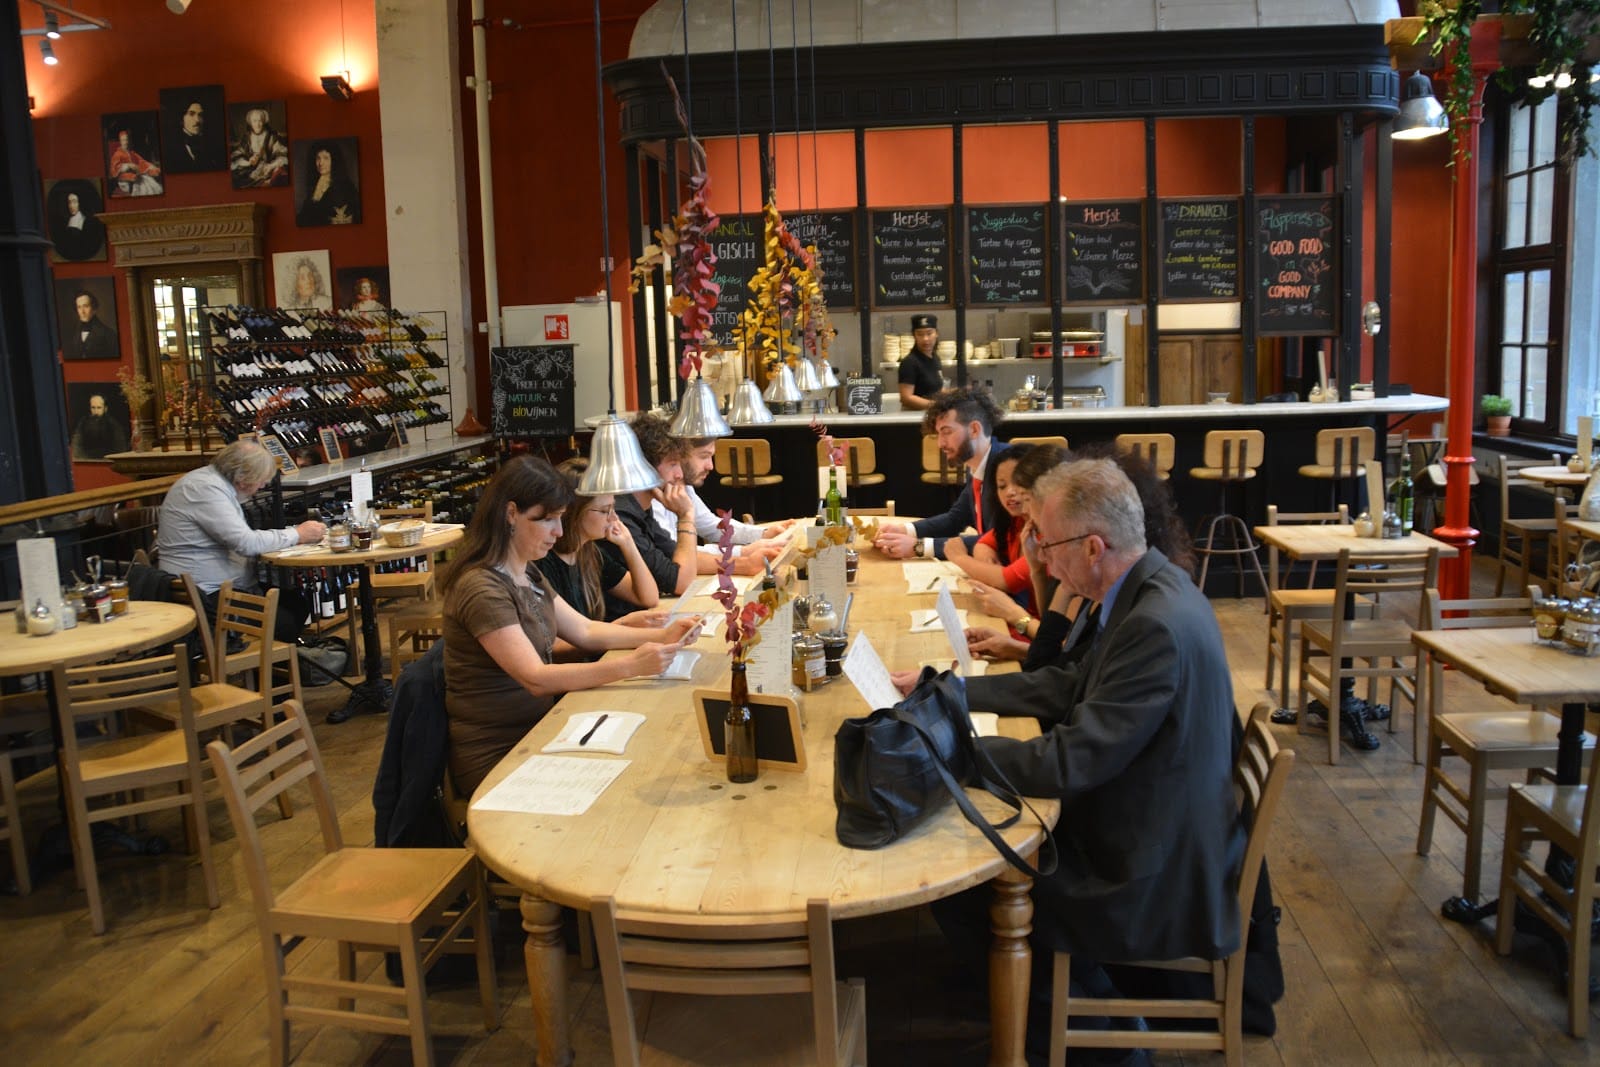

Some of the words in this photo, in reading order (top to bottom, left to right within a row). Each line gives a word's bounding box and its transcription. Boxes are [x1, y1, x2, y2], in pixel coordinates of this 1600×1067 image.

[1083, 207, 1121, 227] Herfst
[1180, 204, 1228, 218] DRANKEN
[892, 211, 932, 228] Herfst
[704, 241, 756, 260] LGISCH
[1269, 240, 1295, 255] GOOD
[1298, 238, 1324, 255] FOOD
[1278, 271, 1302, 283] GOOD
[1268, 285, 1312, 298] COMPANY
[549, 392, 558, 402] &
